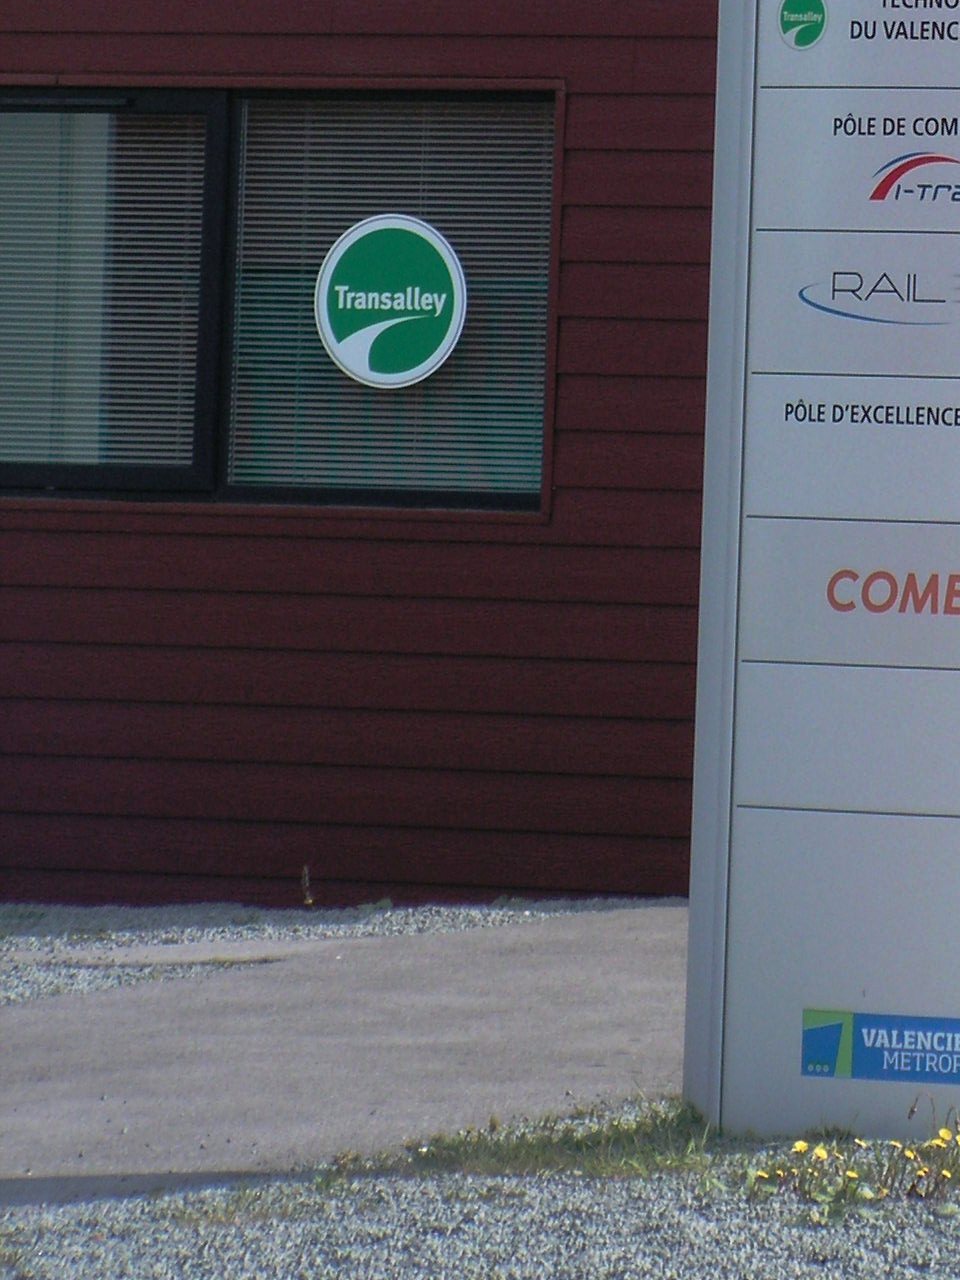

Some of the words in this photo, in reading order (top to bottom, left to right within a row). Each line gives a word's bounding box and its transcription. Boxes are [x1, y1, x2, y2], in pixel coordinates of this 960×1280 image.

[850, 21, 877, 41] DU
[833, 113, 876, 136] PÔLE
[883, 117, 906, 137] DE
[334, 285, 447, 318] Transalley
[785, 399, 826, 423] PÔLE
